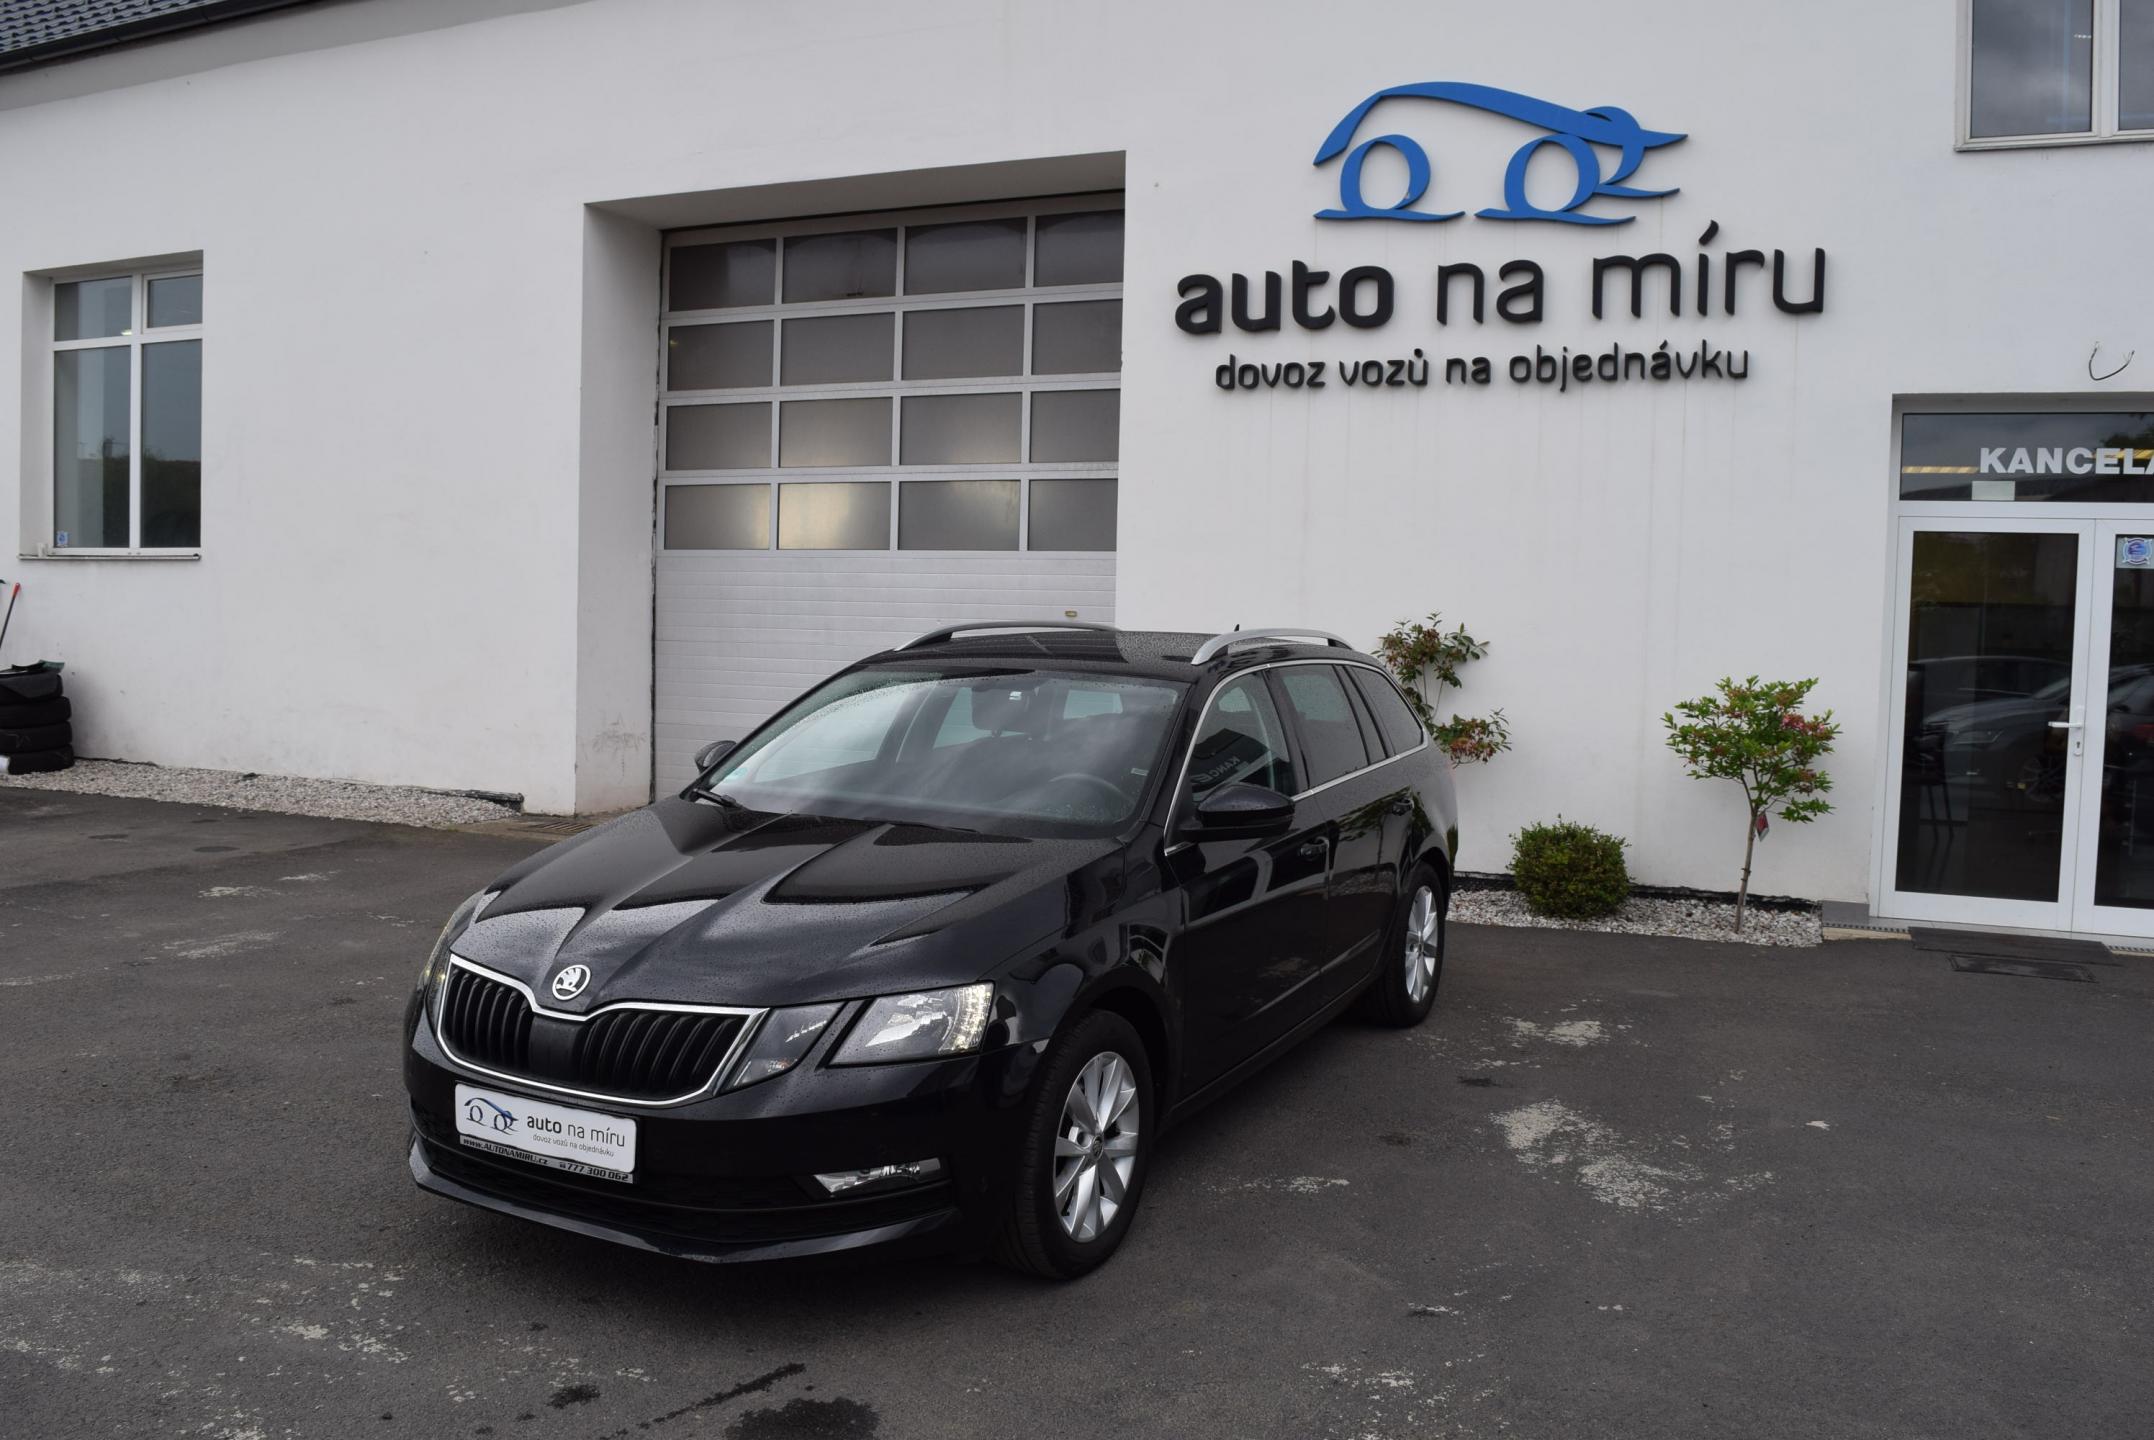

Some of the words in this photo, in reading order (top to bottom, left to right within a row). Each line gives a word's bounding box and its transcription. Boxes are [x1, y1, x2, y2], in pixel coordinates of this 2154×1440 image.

[1174, 259, 1395, 335] auto
[1437, 259, 1545, 325] na
[1592, 219, 1826, 319] míru
[1215, 353, 1326, 391] dovoz
[1339, 347, 1429, 387] vozů
[1446, 354, 1492, 385] na
[1508, 339, 1749, 393] objednávku
[527, 1115, 562, 1134] auto
[567, 1124, 585, 1139] na
[590, 1127, 625, 1147] míru
[567, 1163, 585, 1173] 777
[587, 1166, 606, 1177] 300
[608, 1169, 629, 1182] 062
